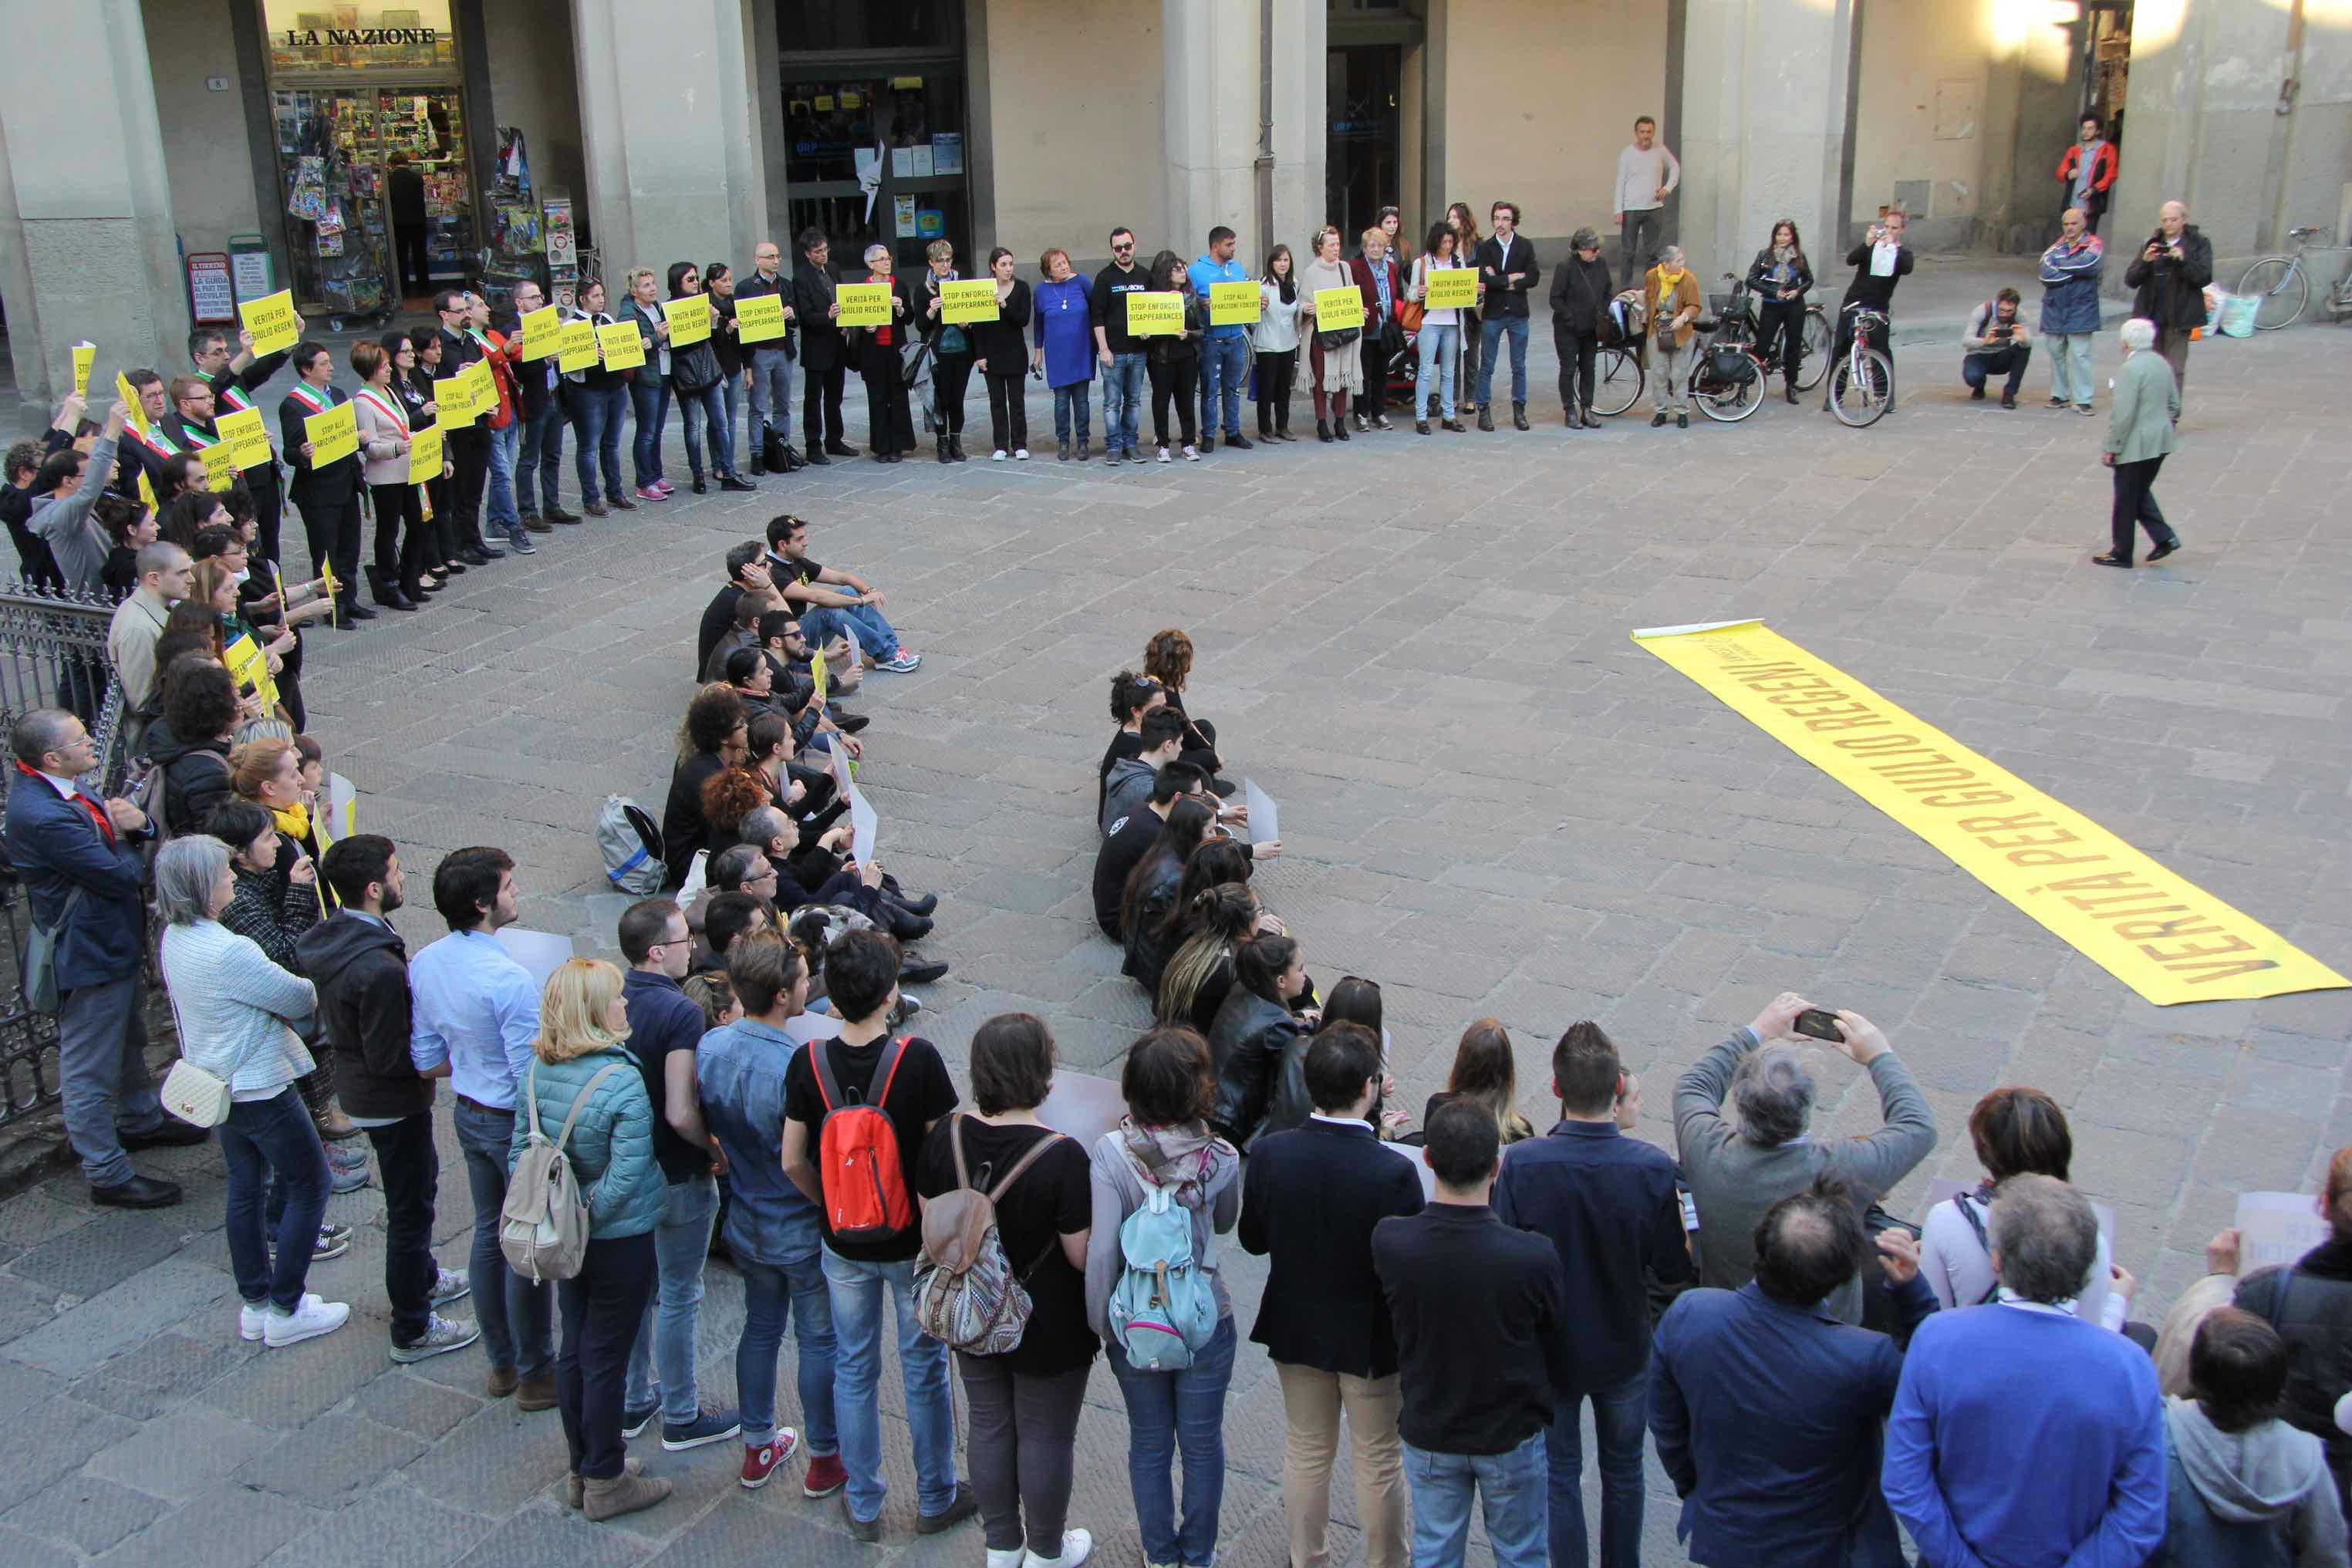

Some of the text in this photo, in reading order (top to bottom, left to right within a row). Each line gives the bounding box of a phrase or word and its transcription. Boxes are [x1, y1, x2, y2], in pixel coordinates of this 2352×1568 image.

[287, 28, 437, 46] LA NAZIONE
[1453, 278, 1471, 287] ABOUT
[869, 295, 881, 303] PER
[943, 289, 994, 301] STOP ENFORCED
[1431, 288, 1473, 298] GIULIO REGENI
[842, 305, 887, 315] GIULIO REGENI
[943, 299, 997, 310] DISAPPEARANCES
[1148, 302, 1180, 310] ENFORCED
[253, 308, 285, 325] VERITÀ PER
[671, 307, 705, 322] TRUTH ABOUT
[739, 305, 781, 319] STOP ENFORCED
[1129, 312, 1183, 322] DISAPPEARANCES
[1321, 308, 1359, 319] GIULIO REGENI
[673, 323, 692, 333] GIULIO
[740, 315, 783, 329] DISAPPEARANCES
[252, 320, 293, 340] GIULIO REGENI
[562, 332, 593, 346] TOP ENFORCED
[605, 332, 636, 346] TRUTH ABOUT
[623, 345, 640, 355] REGENI
[221, 421, 262, 440] STOP ENFORCED
[322, 420, 345, 436] STOP ALLE
[232, 434, 267, 452] APPEARANCES
[314, 435, 339, 448] PARIZIONI
[204, 454, 230, 469] ENFORCED
[1719, 661, 2280, 985] VERITÀ PER GIULIO REGENI
